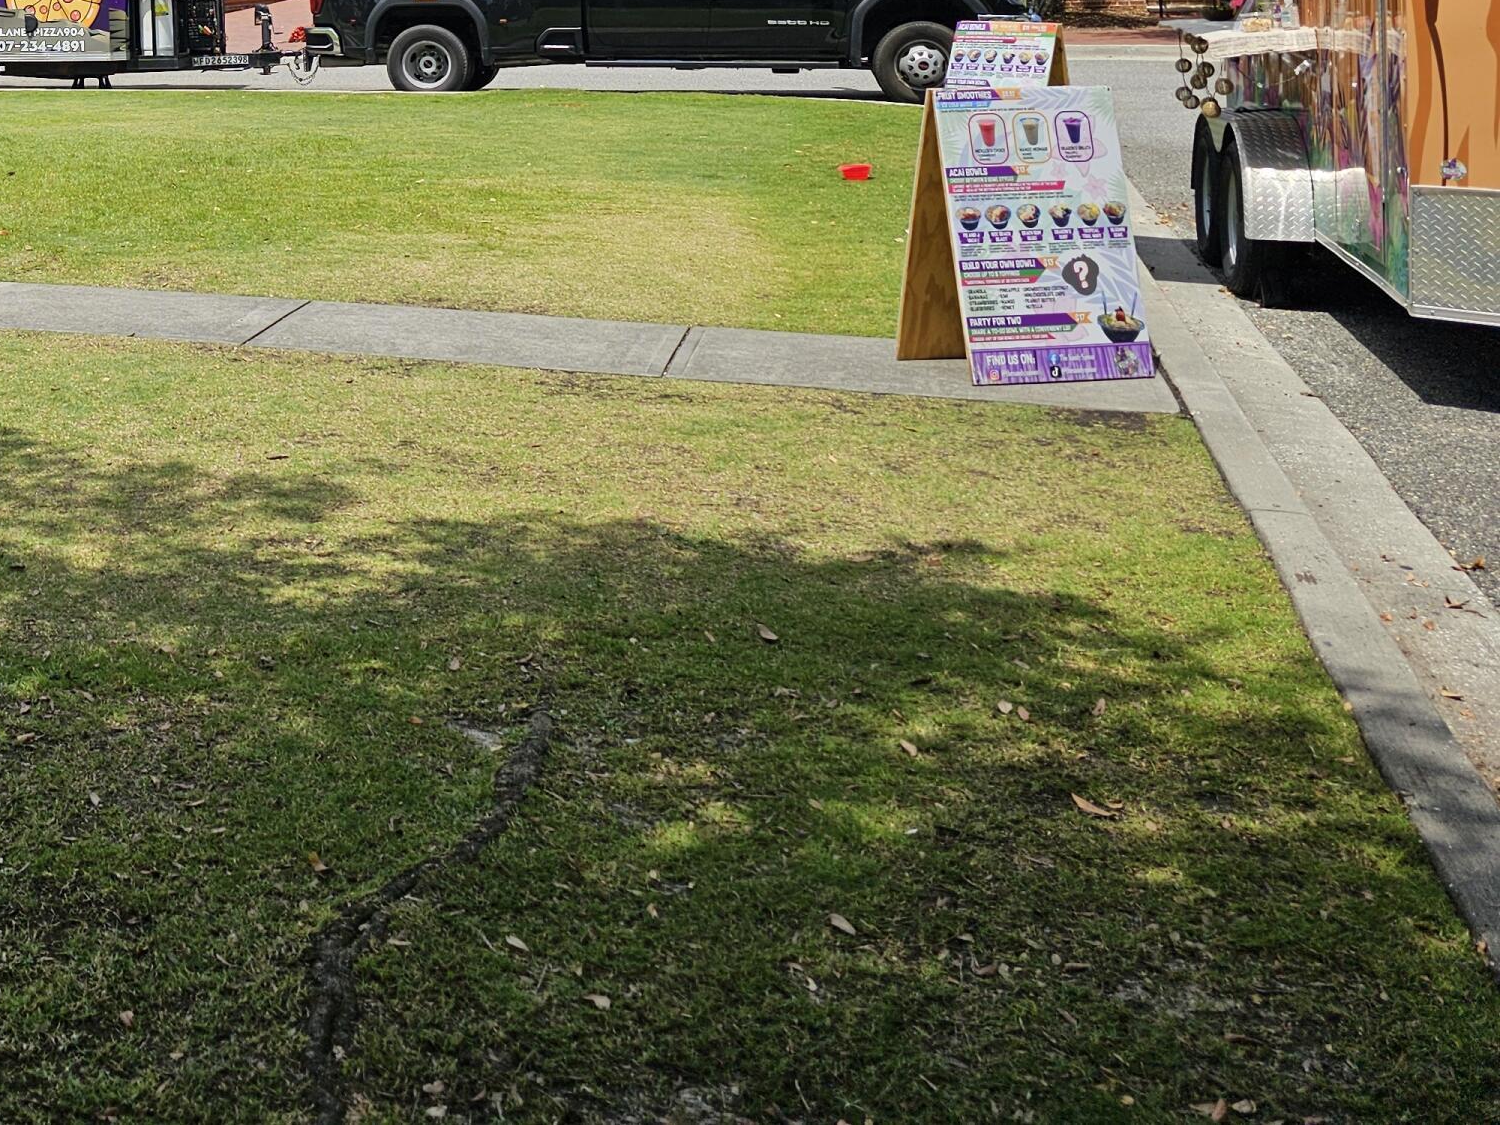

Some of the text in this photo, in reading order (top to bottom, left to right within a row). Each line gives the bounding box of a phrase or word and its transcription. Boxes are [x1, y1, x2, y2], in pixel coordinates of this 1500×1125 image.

[957, 90, 991, 100] SMOOTHIES
[965, 167, 988, 176] BOWLS
[961, 261, 980, 270] BUILD
[981, 260, 999, 269] YOUR
[999, 259, 1015, 269] OWN
[969, 317, 991, 327] PARTY
[992, 317, 1006, 326] FOR
[1007, 316, 1021, 325] TWO
[1007, 355, 1019, 365] US
[1020, 354, 1036, 364] ON:
